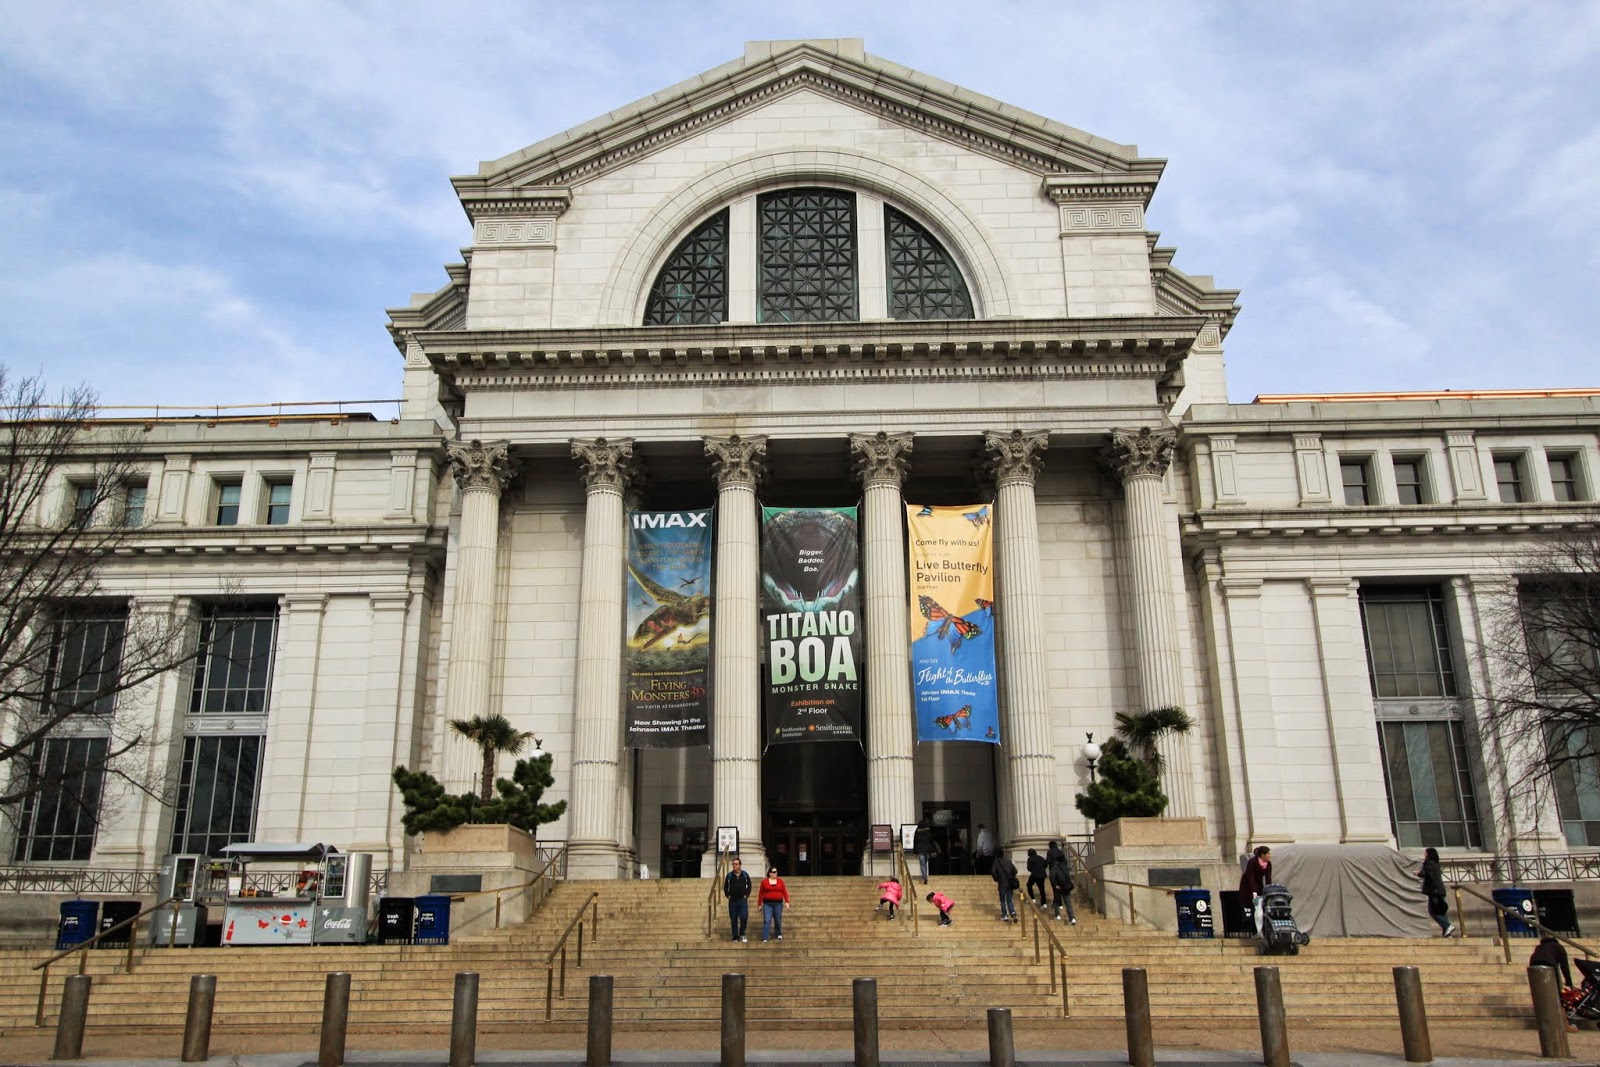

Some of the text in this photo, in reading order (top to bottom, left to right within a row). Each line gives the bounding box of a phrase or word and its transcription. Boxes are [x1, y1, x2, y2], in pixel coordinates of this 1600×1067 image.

[633, 512, 707, 529] IMAX
[916, 560, 988, 575] Live Butterfly
[917, 573, 961, 582] Pavilion
[767, 610, 855, 640] TITANO
[770, 636, 858, 685] BOA
[917, 667, 946, 685] Flight
[953, 669, 993, 685] Butterflies
[650, 680, 686, 690] FLYING
[772, 684, 818, 694] MONSTER
[630, 690, 690, 701] MONSTERS
